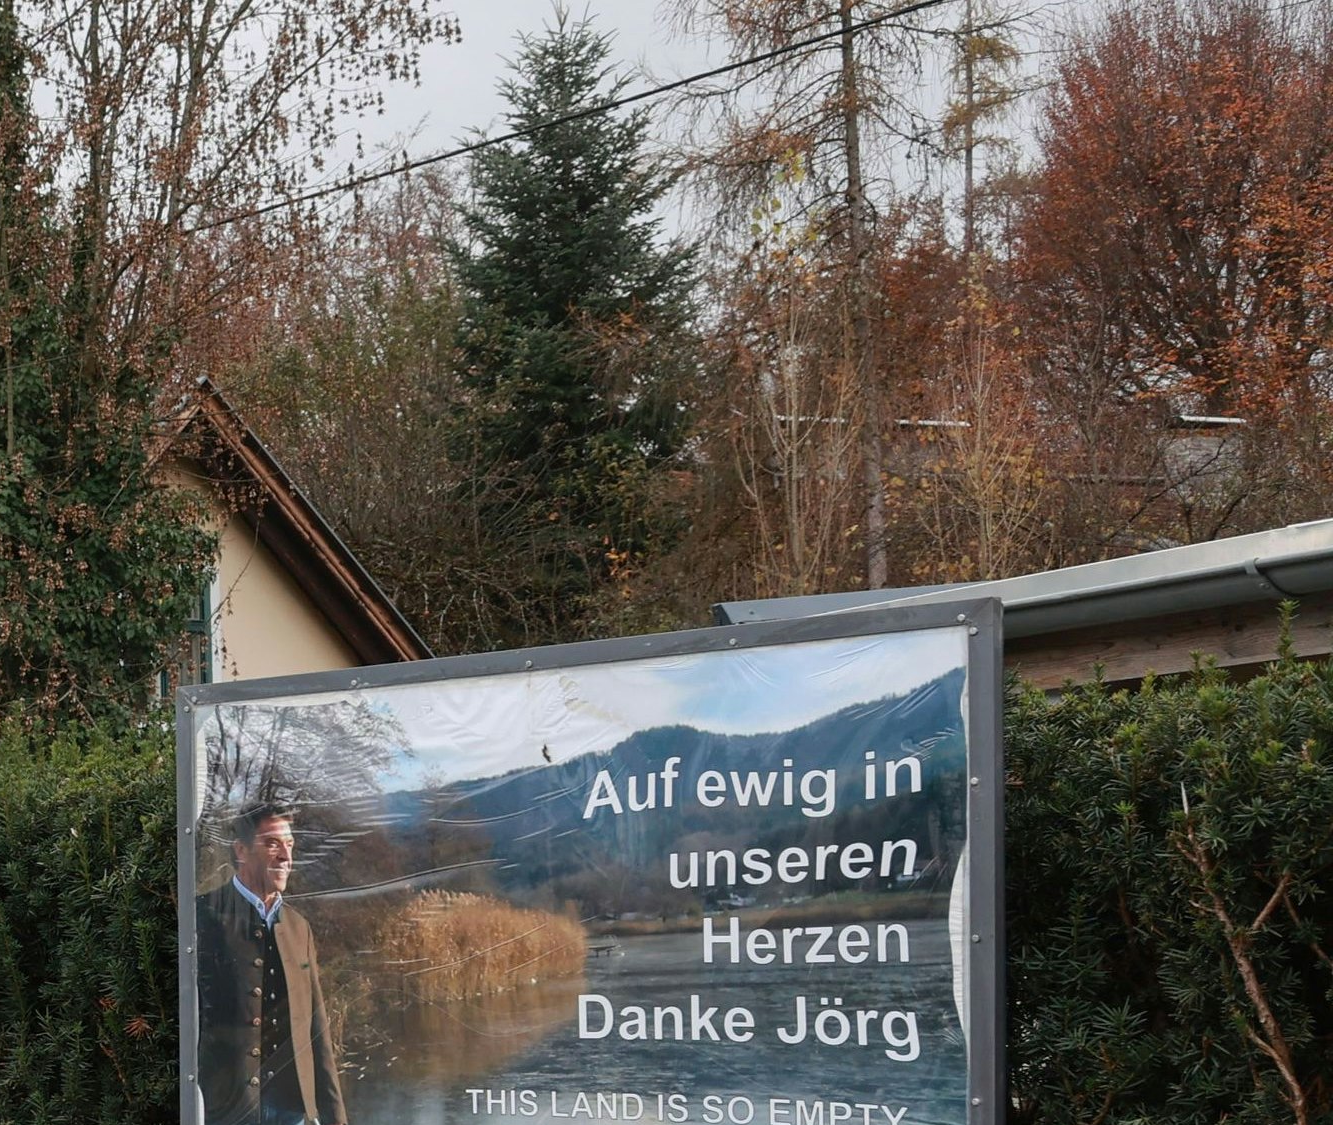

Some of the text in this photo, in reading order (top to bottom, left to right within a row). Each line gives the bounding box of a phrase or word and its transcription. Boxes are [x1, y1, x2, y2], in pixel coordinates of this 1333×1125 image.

[582, 750, 923, 819] Auf ewig in
[669, 838, 919, 889] unseren
[702, 916, 910, 965] Herzen
[578, 994, 921, 1062] Danke Jörg
[465, 1088, 539, 1117] THIS
[550, 1091, 644, 1121] LAND
[657, 1094, 689, 1123] IS
[701, 1095, 755, 1125] SO
